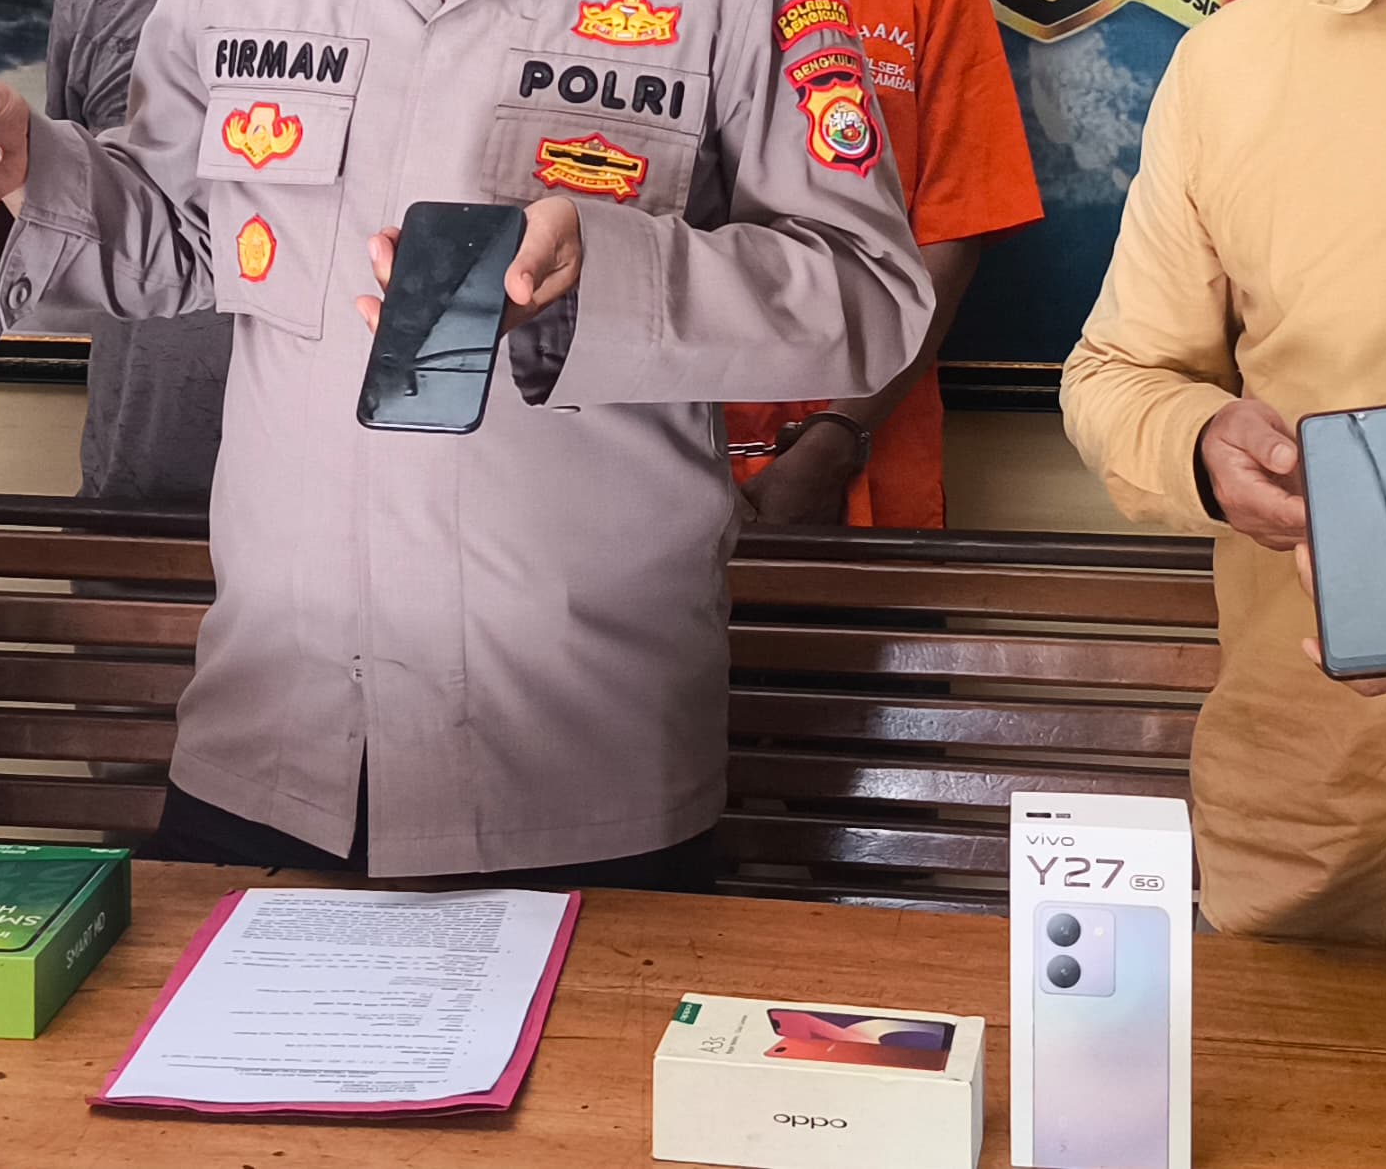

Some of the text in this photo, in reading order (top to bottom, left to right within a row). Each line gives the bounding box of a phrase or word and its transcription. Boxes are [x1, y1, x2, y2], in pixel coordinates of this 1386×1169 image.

[215, 39, 349, 84] FIRMAN
[519, 60, 686, 122] POLRI
[1026, 832, 1075, 846] vivo
[1026, 855, 1159, 889] Y27 5G
